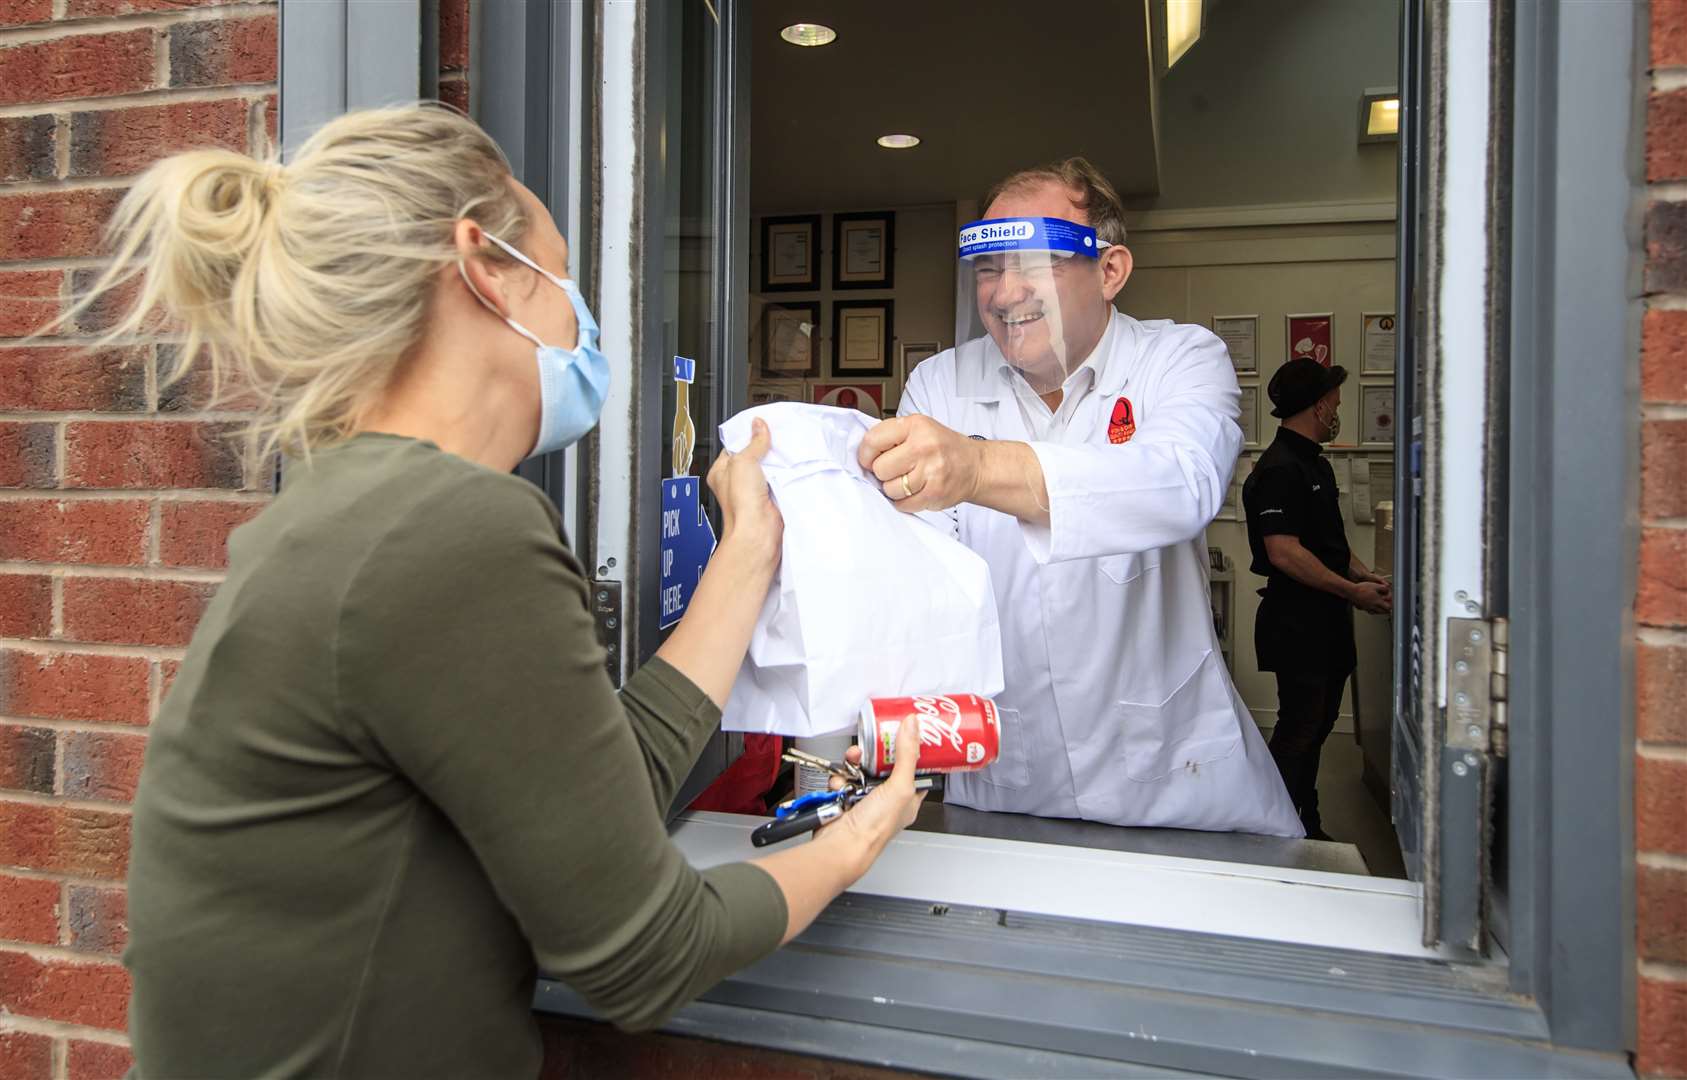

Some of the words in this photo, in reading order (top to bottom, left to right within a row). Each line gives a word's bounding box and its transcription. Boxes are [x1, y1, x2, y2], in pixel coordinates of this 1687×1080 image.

[960, 232, 977, 243] Face
[981, 225, 1026, 239] Shield
[988, 240, 1018, 249] protection
[663, 509, 680, 539] PICK
[663, 549, 674, 578] UP
[663, 584, 684, 617] HERE.
